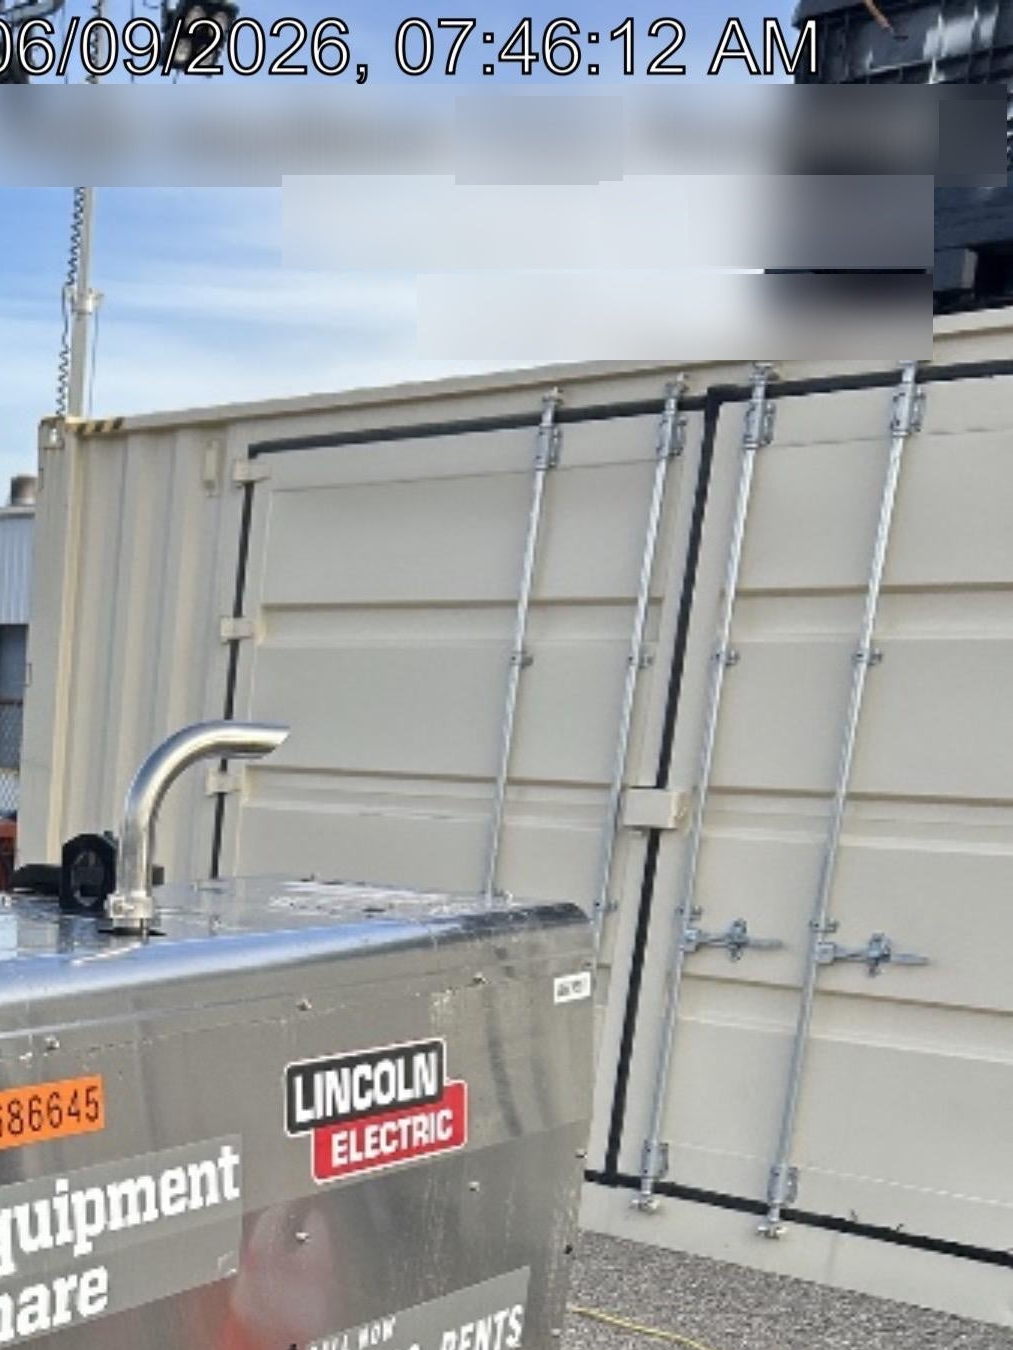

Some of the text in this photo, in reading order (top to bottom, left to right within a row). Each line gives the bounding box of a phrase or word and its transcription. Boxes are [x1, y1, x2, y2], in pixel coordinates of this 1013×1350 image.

[294, 1051, 438, 1124] LINCOLN
[330, 1107, 454, 1169] ELECTRIC
[358, 1314, 397, 1350] NOW
